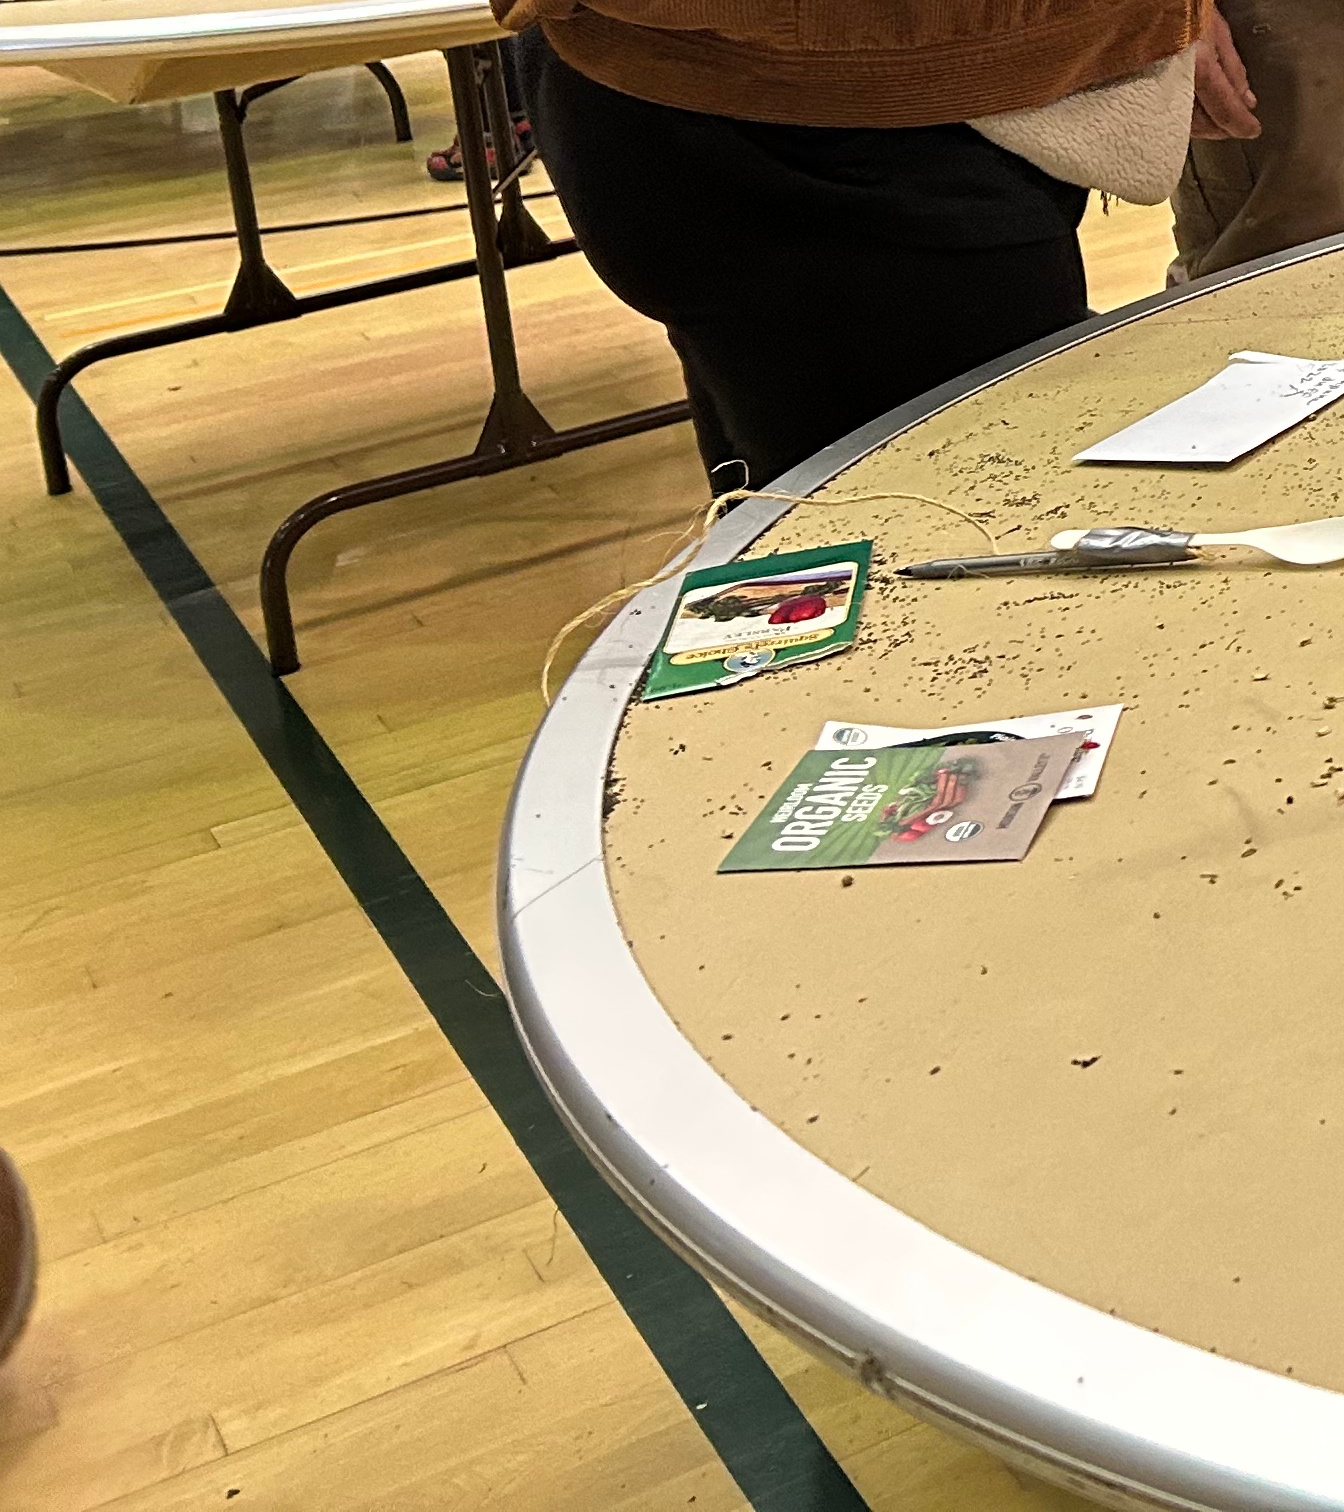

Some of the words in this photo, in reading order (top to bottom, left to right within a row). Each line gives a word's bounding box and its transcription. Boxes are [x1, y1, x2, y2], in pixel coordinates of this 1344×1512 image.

[685, 645, 738, 661] Choice
[770, 755, 877, 853] ORGANIC
[840, 783, 889, 823] SEEDS
